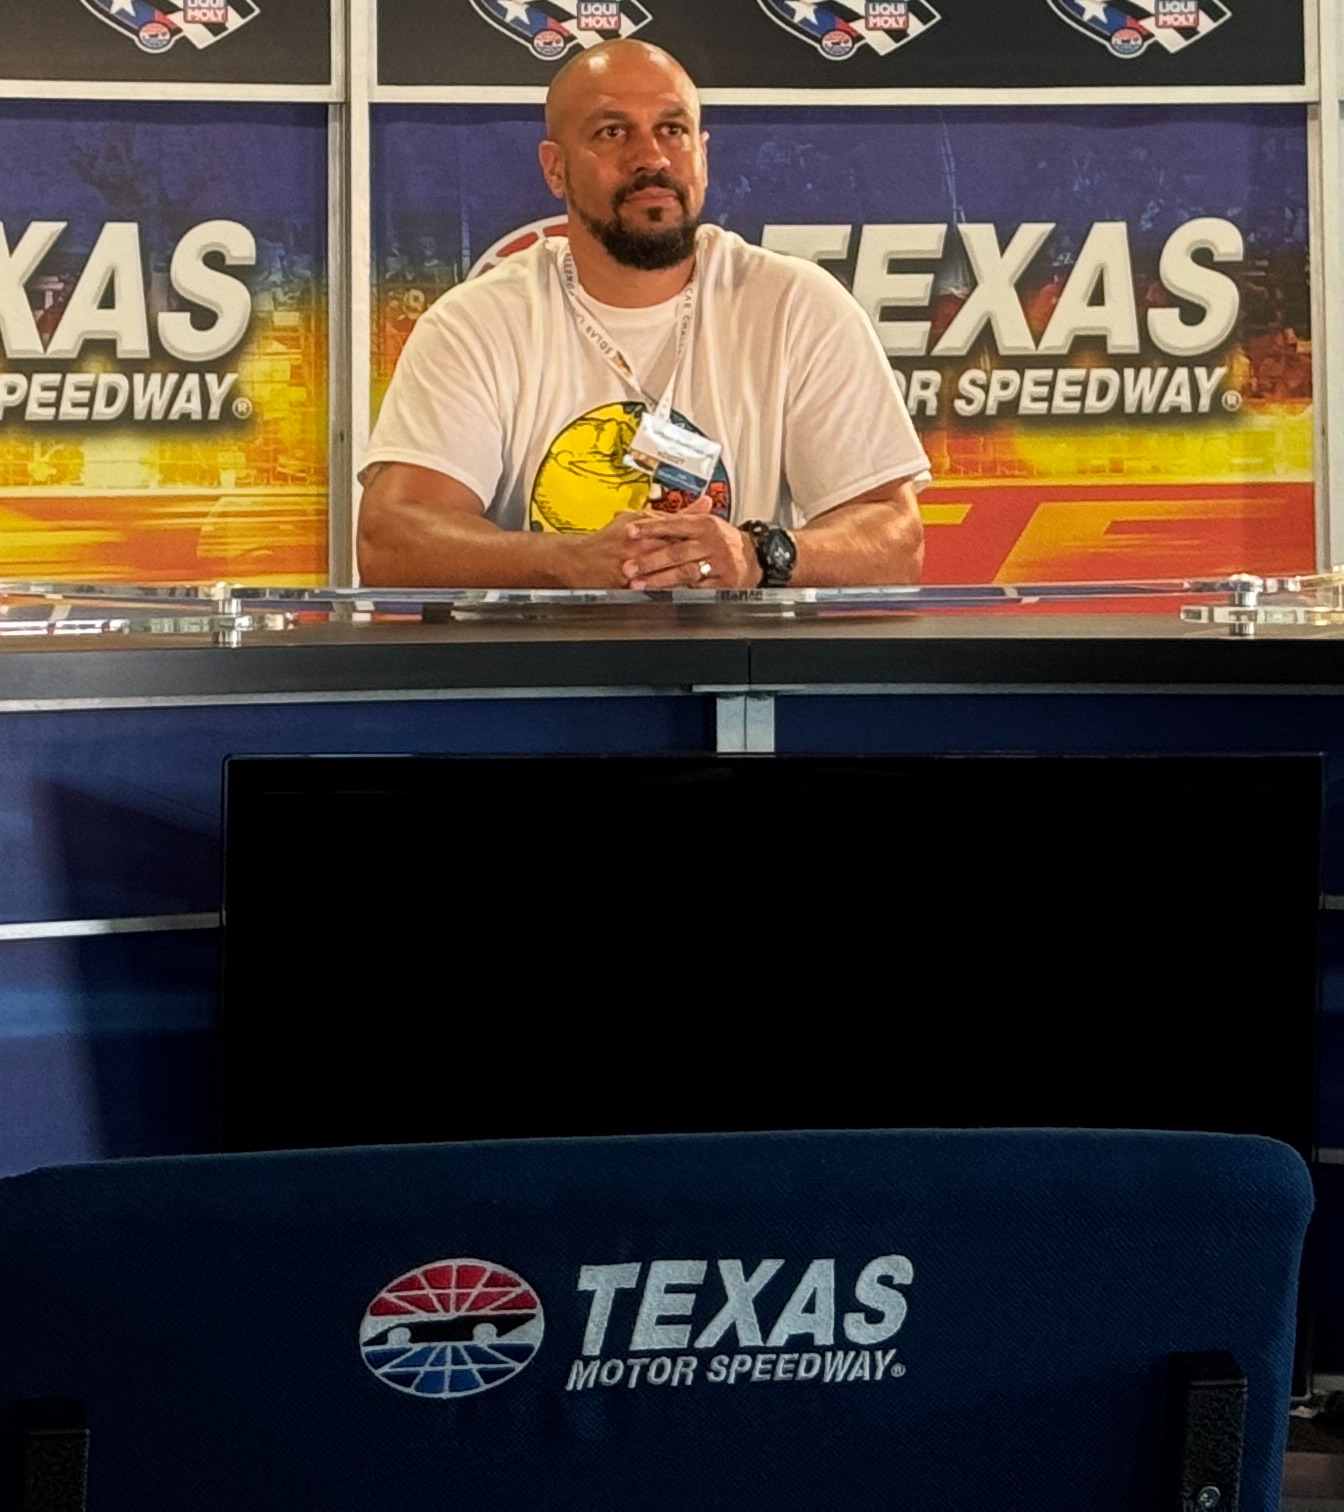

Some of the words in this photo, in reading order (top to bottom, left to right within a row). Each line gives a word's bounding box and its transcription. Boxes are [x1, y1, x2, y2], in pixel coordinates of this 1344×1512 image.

[580, 2, 617, 15] LIQUI
[868, 2, 905, 15] LIQUI
[1158, 0, 1197, 13] LIQUI
[186, 8, 226, 22] MOLY
[1158, 13, 1197, 27] MOLY
[580, 16, 619, 29] MOLY
[868, 16, 907, 29] MOLY
[577, 1254, 913, 1356] TEXAS
[566, 1355, 698, 1391] MOTOR
